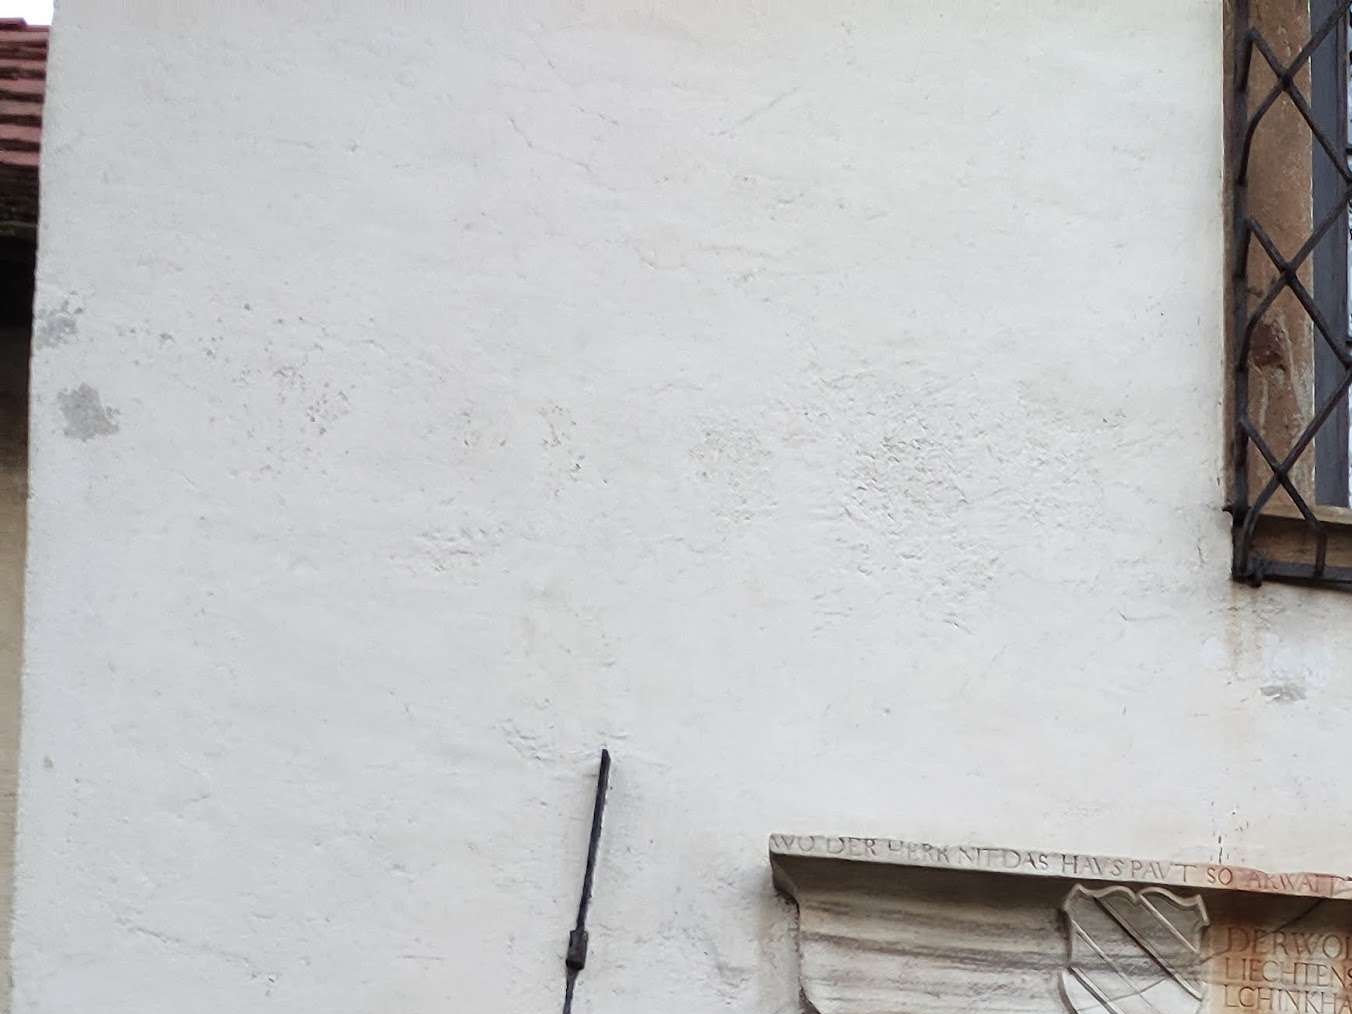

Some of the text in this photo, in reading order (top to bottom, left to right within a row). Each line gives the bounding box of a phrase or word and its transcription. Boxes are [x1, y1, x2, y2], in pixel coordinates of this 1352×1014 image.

[827, 837, 877, 856] DER
[1001, 848, 1048, 870] DAS
[1207, 867, 1233, 885] SO
[1226, 927, 1289, 956] DER
